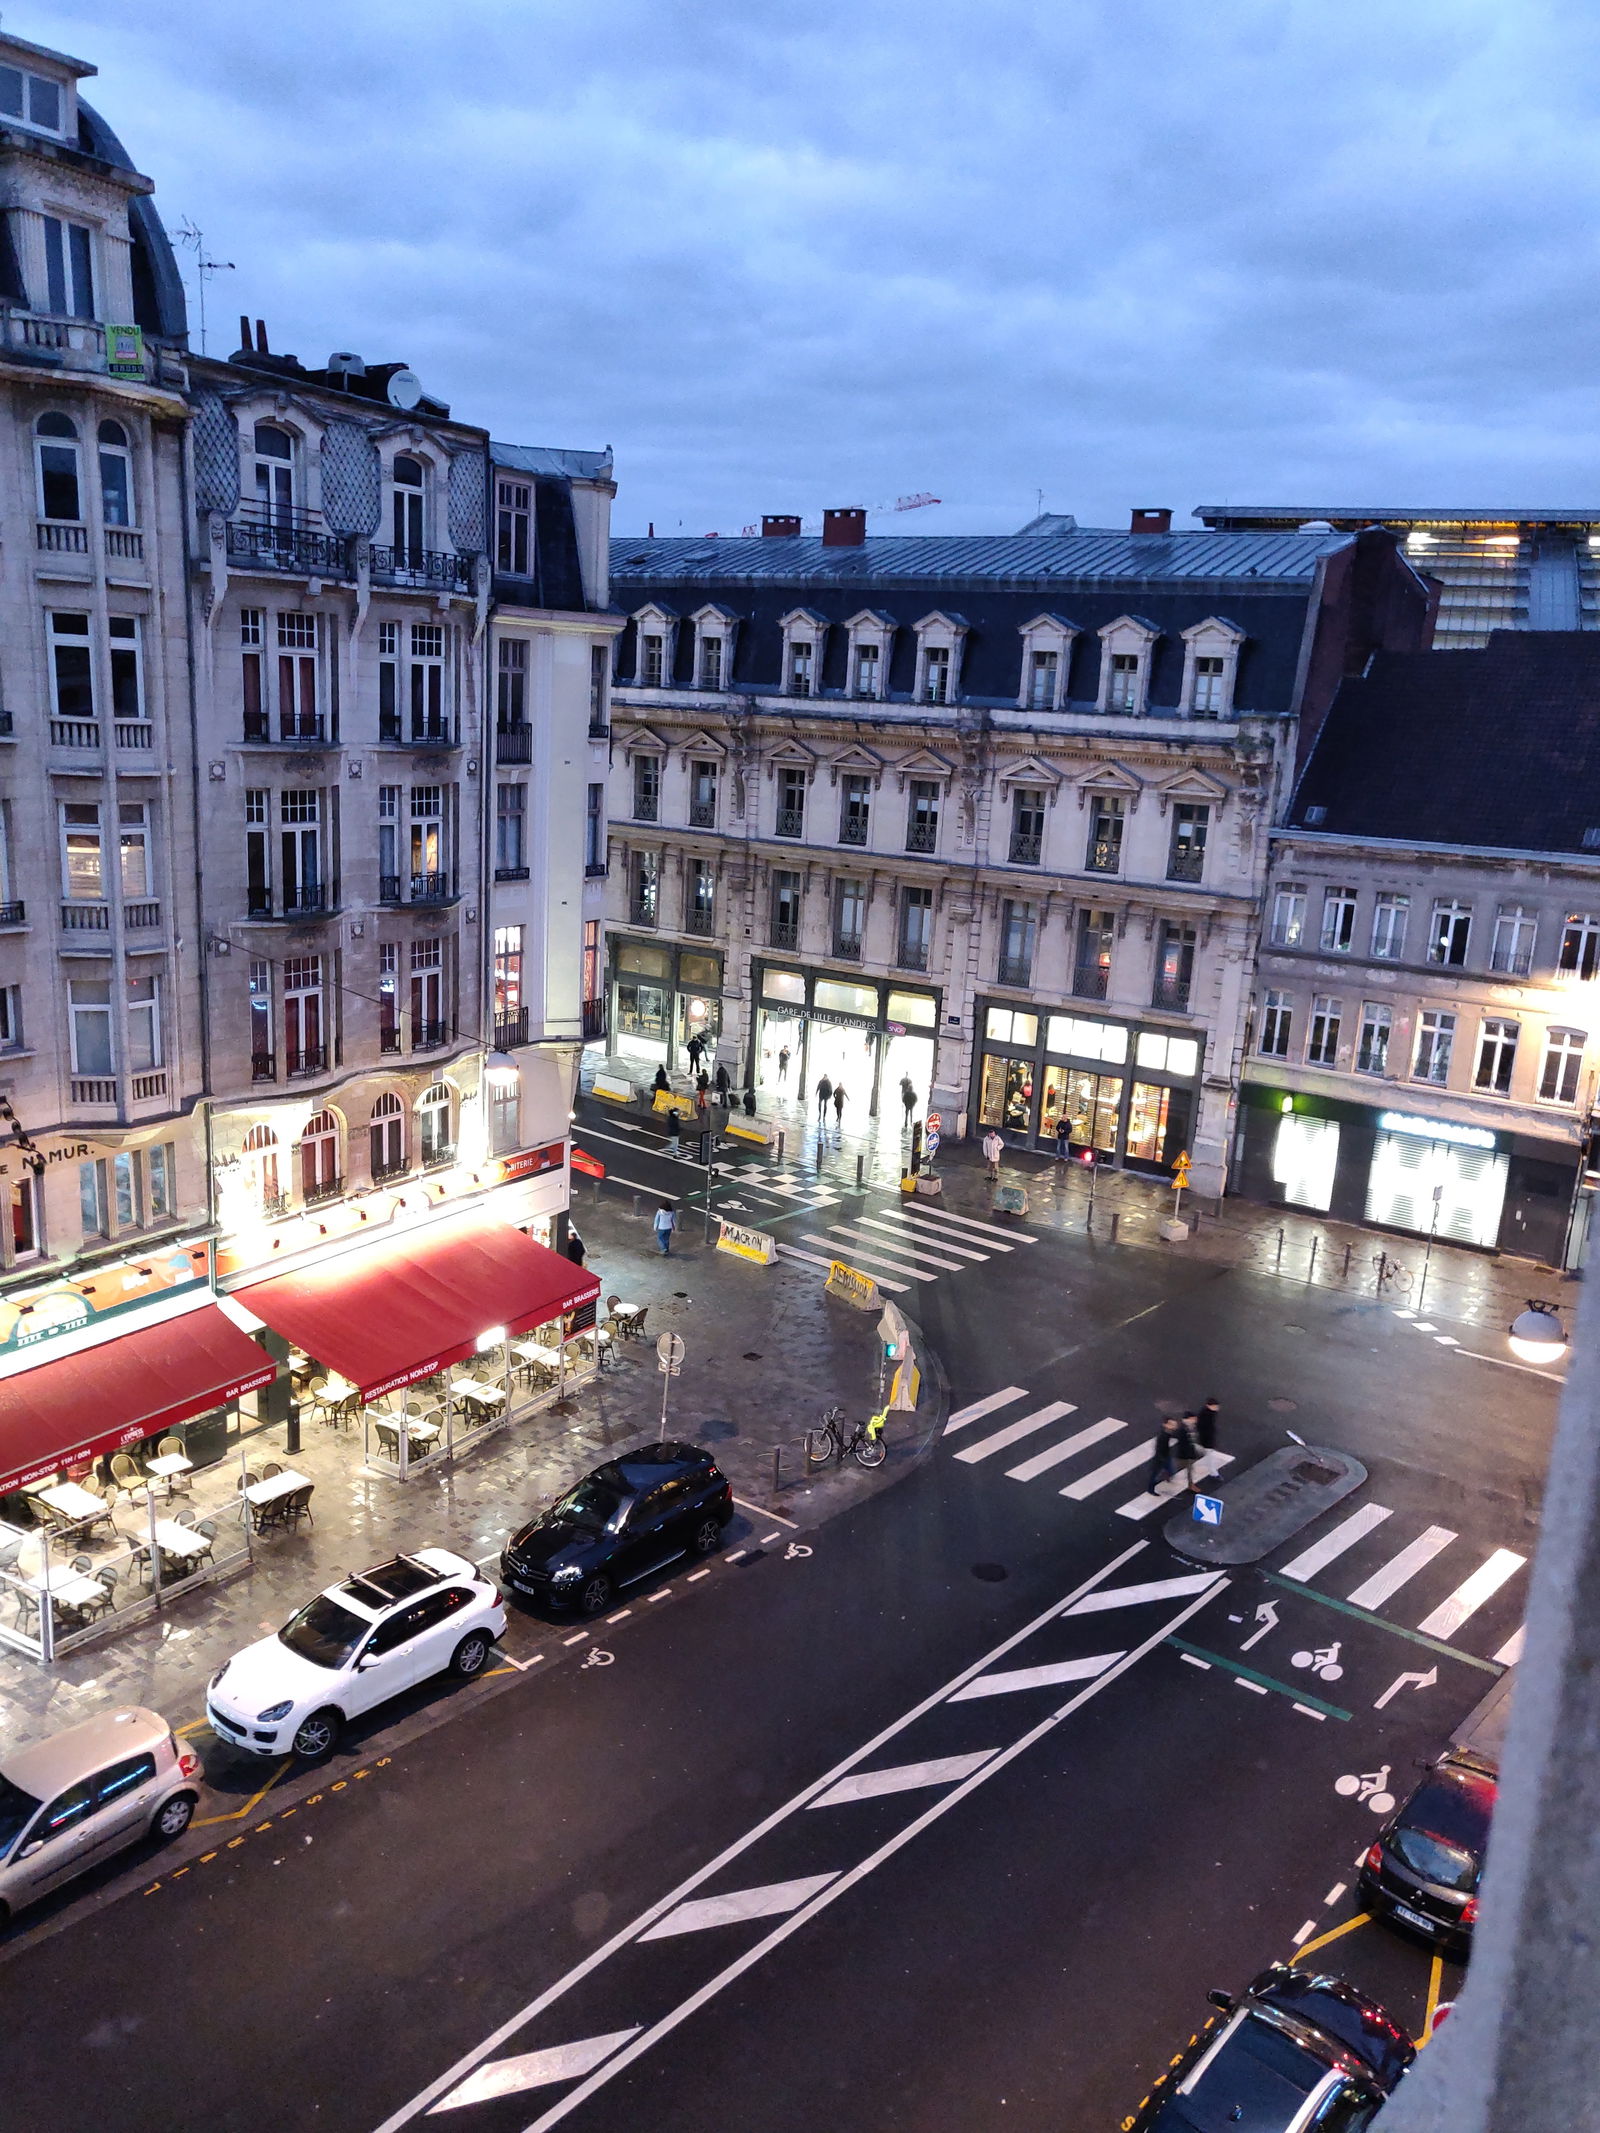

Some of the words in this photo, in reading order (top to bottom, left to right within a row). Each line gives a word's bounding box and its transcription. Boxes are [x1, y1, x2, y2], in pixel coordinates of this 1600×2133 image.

[110, 325, 140, 336] VENDU
[777, 1006, 798, 1017] GARE
[800, 1010, 811, 1019] DE
[813, 1012, 832, 1022] LILLE
[834, 1016, 876, 1031] FLANDRES
[888, 1025, 906, 1034] SNCF
[724, 1225, 763, 1252] MACRON
[562, 1299, 573, 1309] BAR
[573, 1287, 600, 1304] BRASSERIE
[225, 1387, 239, 1398] BAR
[239, 1373, 272, 1392] BRASSERIE
[364, 1373, 409, 1400] RESTAURATION
[409, 1360, 439, 1380] NON-STOP
[21, 1462, 59, 1483] NON-STOP
[143, 1757, 392, 1896] LIVRAISONS
